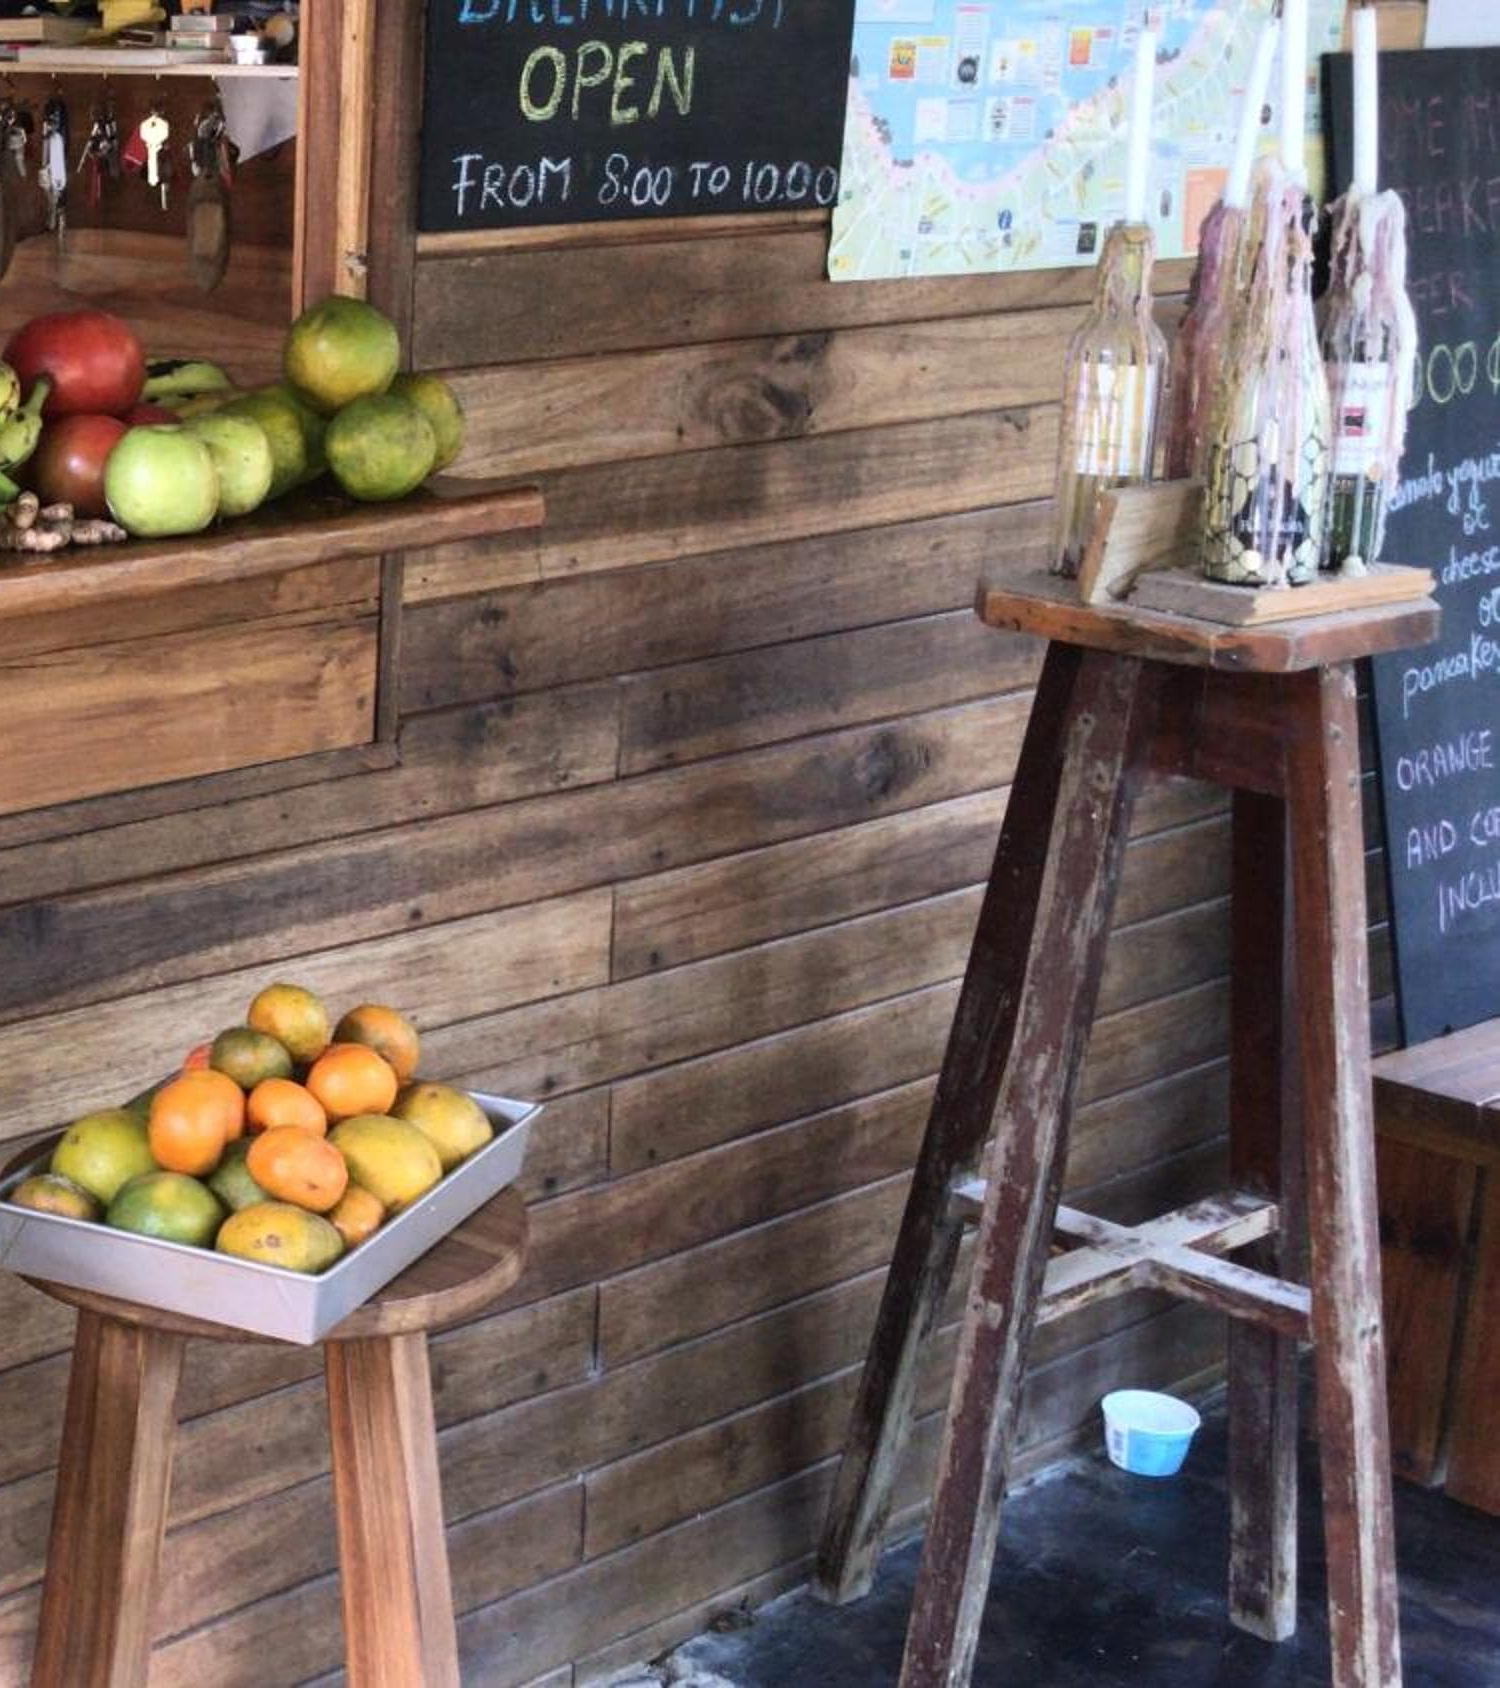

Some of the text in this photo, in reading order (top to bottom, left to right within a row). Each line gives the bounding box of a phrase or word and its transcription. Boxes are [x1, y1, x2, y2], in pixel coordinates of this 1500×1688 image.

[520, 40, 695, 125] OPEN
[452, 153, 572, 216] FROM
[688, 162, 730, 195] TO
[1397, 730, 1493, 791] ORANGE
[1407, 819, 1456, 869] AND
